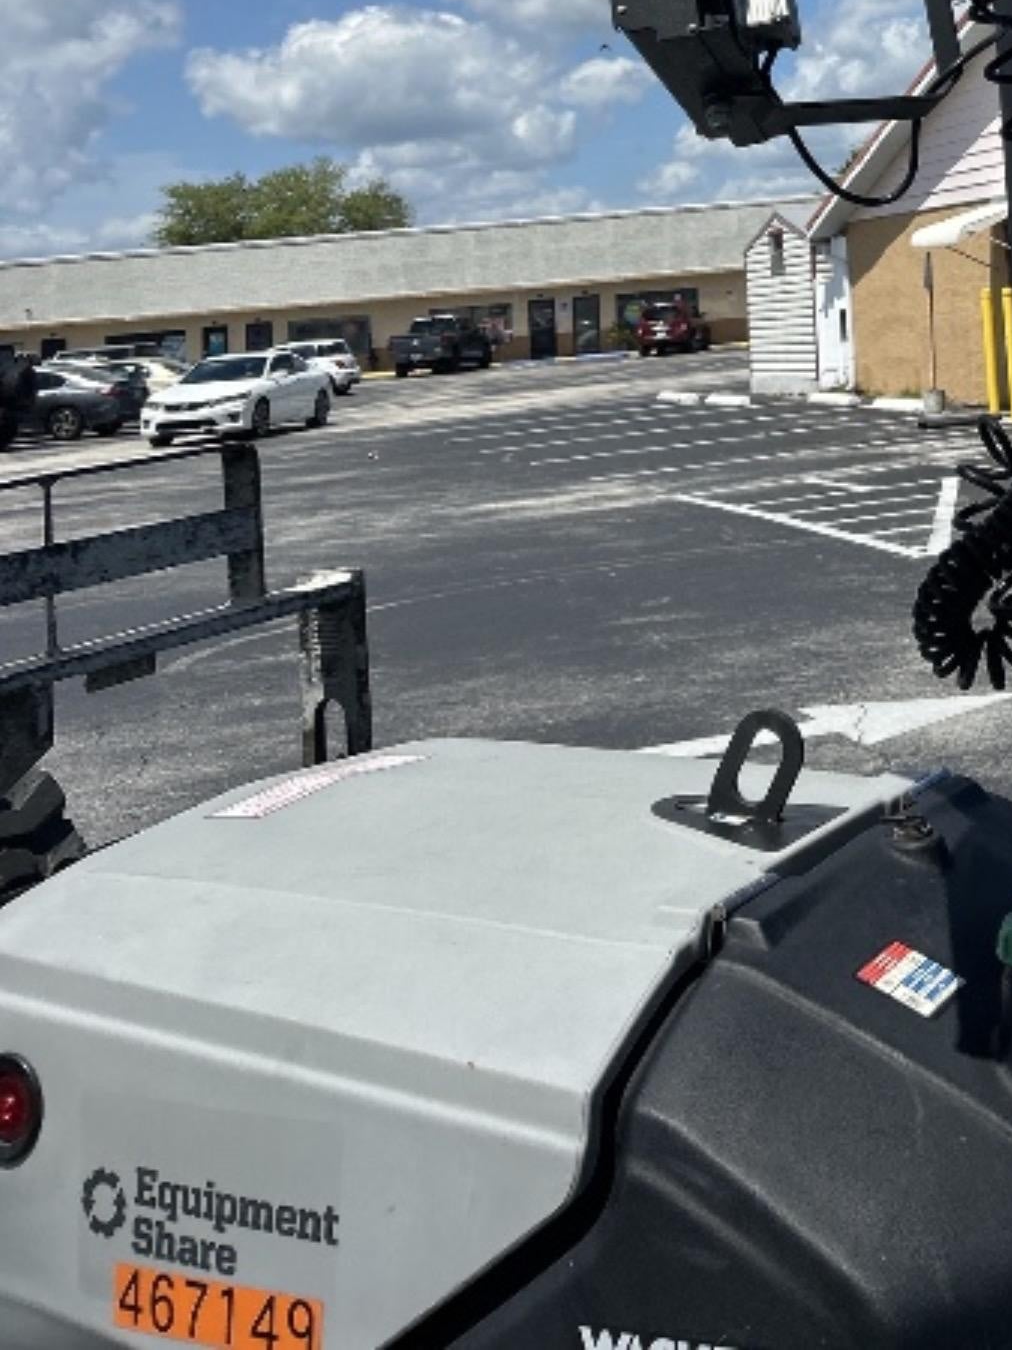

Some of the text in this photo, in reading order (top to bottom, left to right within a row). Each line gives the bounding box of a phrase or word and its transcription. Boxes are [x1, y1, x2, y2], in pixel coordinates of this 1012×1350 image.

[131, 1216, 238, 1275] Share
[134, 1166, 340, 1247] Equipment
[118, 1269, 315, 1350] 467149
